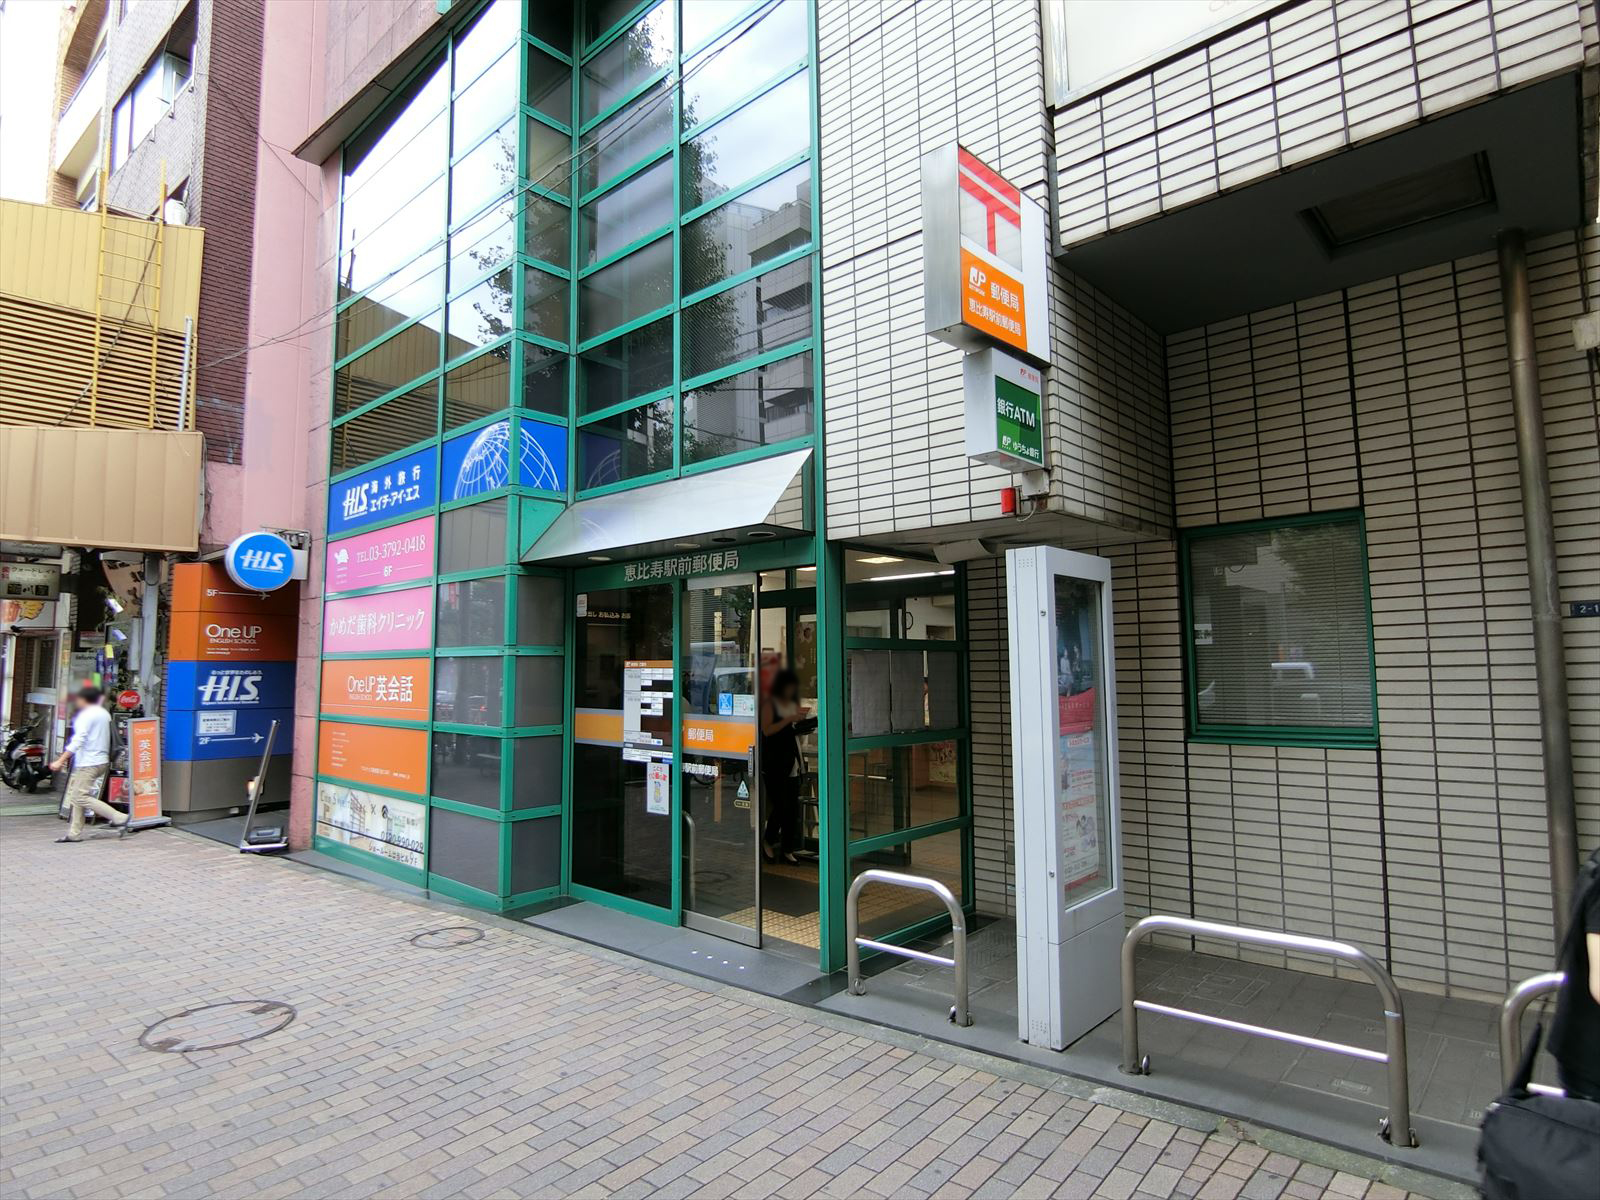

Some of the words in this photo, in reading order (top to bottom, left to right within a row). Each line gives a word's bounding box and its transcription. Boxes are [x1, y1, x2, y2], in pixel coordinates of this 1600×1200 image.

[991, 282, 1019, 313] 郵便局
[997, 398, 1035, 428] 銀行ATM
[624, 550, 739, 582] 恵比寿駅前郵便局
[329, 608, 425, 636] かめだ歯科クリニック
[376, 675, 413, 702] 英会話
[688, 728, 713, 742] 郵便局
